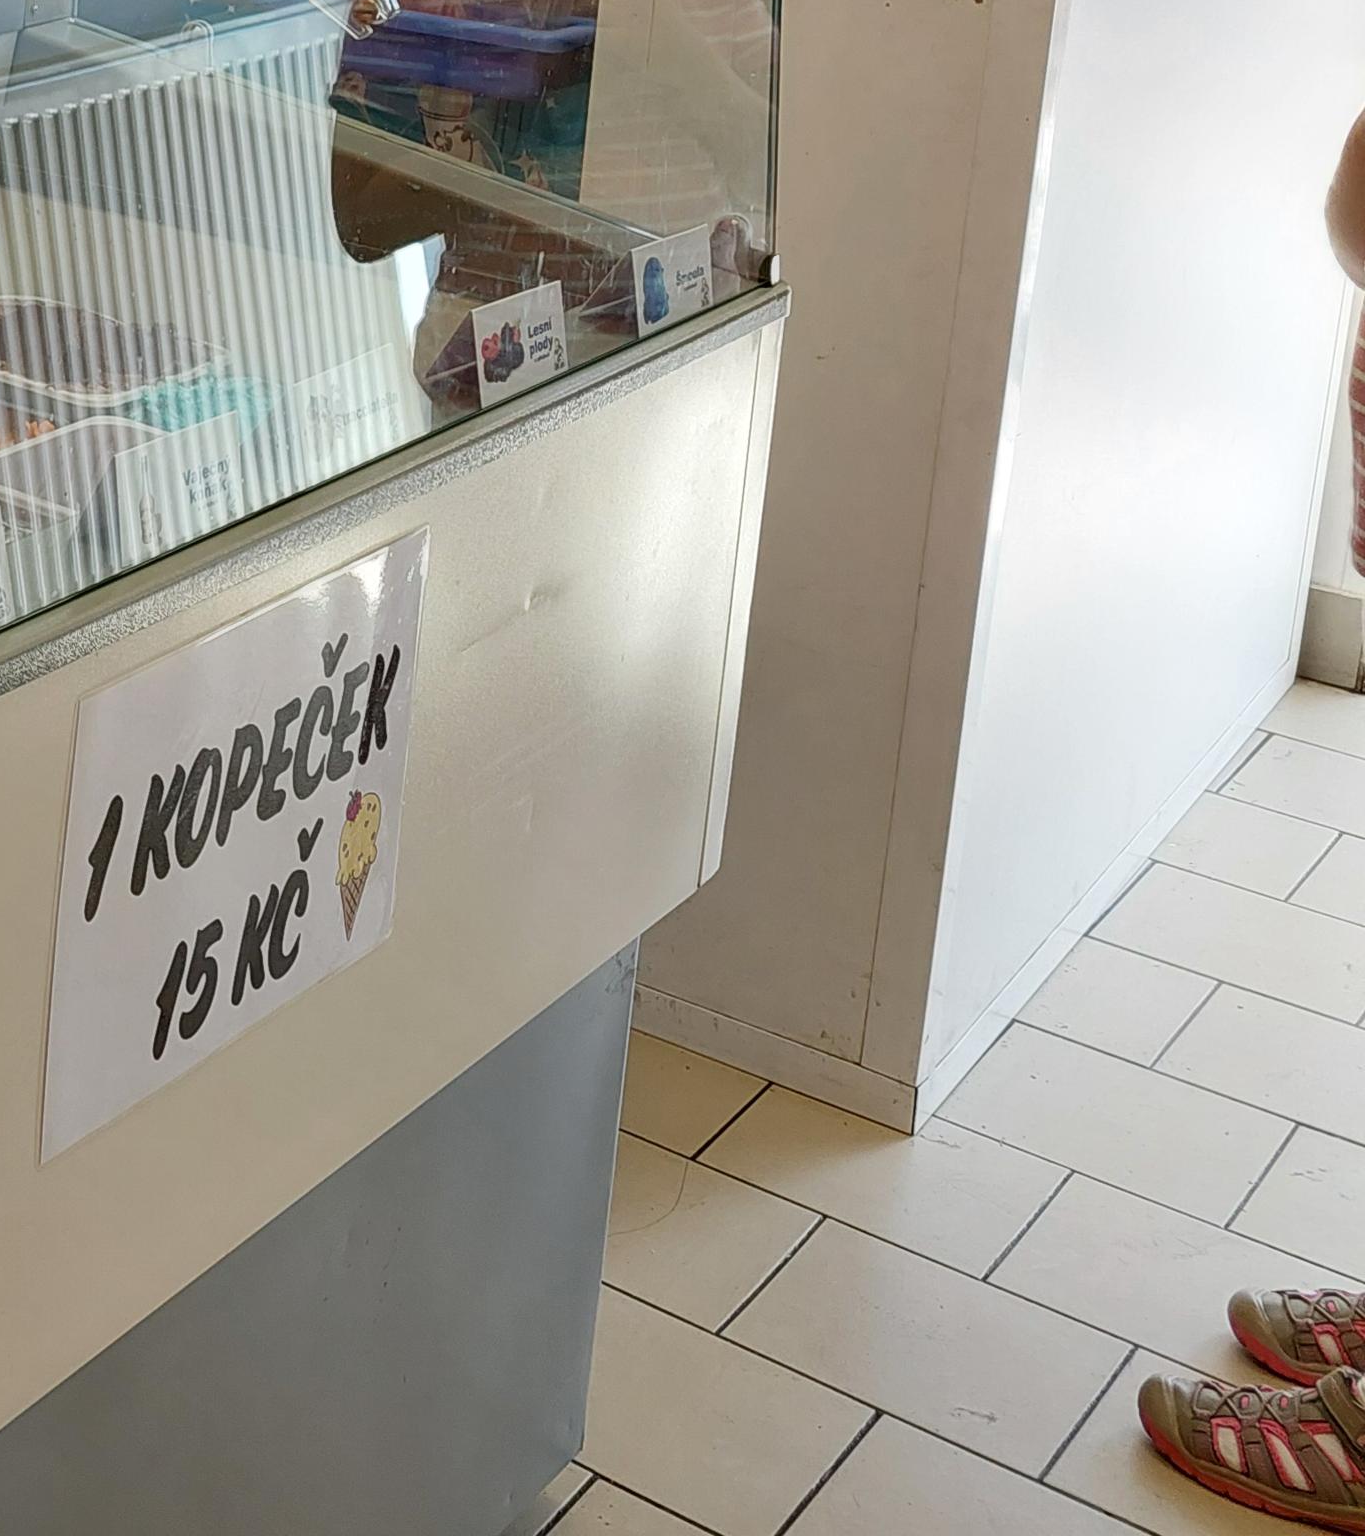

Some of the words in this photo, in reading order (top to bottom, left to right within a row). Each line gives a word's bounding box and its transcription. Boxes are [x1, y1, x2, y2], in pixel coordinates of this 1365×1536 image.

[527, 316, 552, 339] Lesní
[530, 336, 553, 360] plody
[83, 794, 123, 923] 1
[129, 632, 401, 897] KOPEČEK
[153, 918, 223, 1061] 15
[231, 817, 325, 1008] KČ
